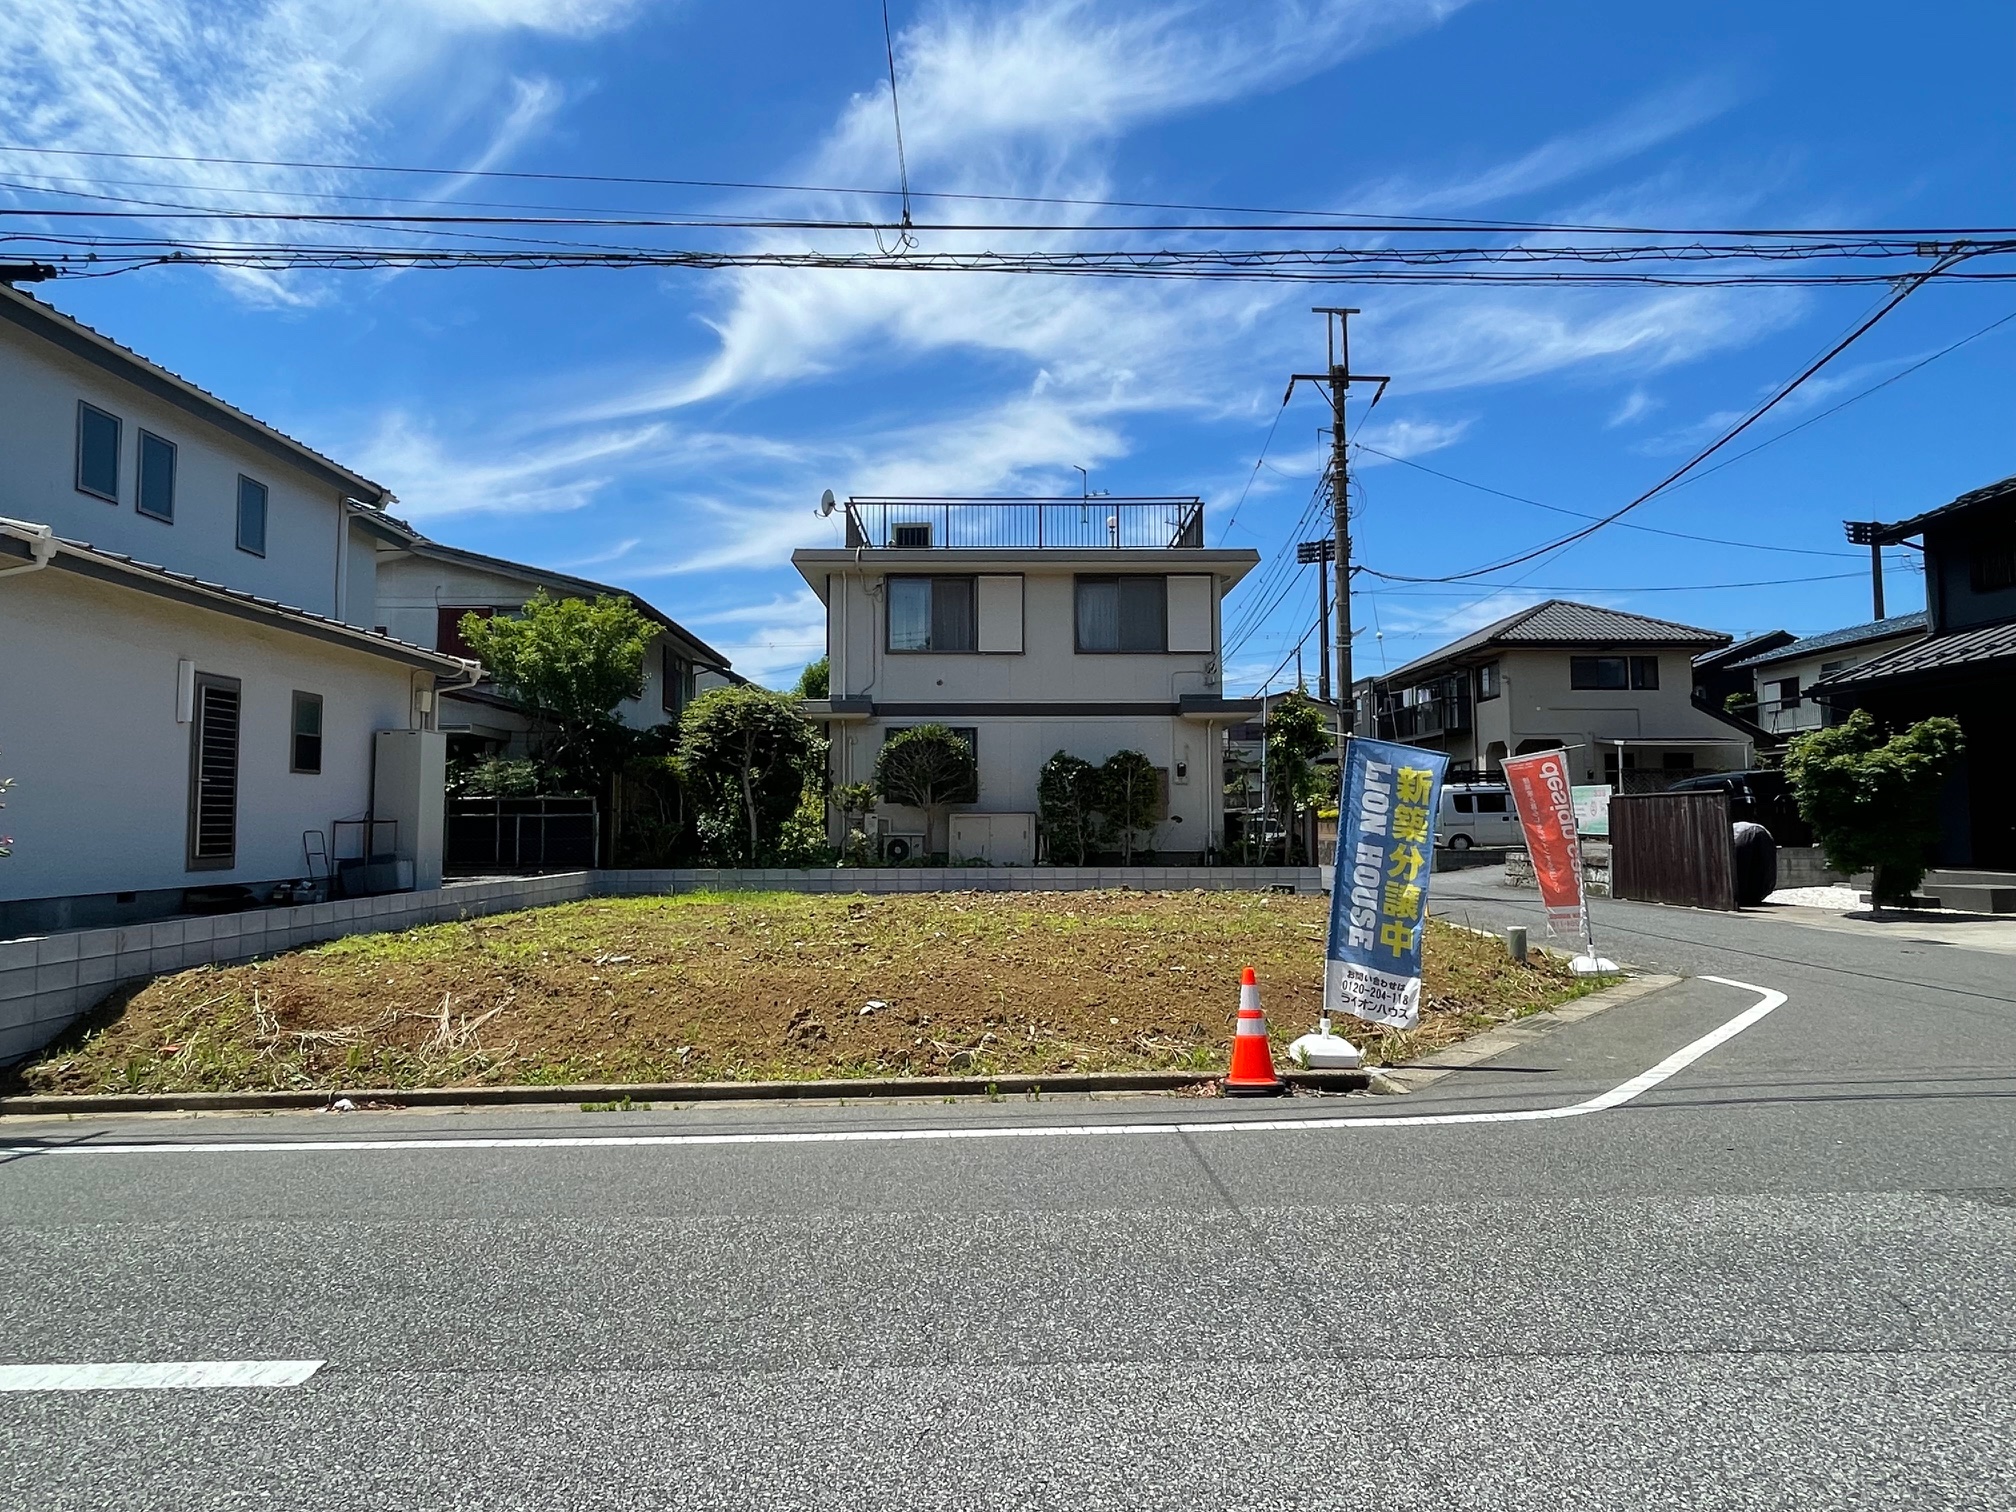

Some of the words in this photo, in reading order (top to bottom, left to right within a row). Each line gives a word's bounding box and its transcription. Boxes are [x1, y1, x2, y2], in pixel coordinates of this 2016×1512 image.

[1359, 759, 1392, 836] LION
[1380, 765, 1434, 958] 新築分譲中
[1348, 842, 1384, 951] HOUSE
[1341, 992, 1409, 1020] ライオンハウス
[1342, 980, 1409, 1006] 0120-204-118
[1347, 970, 1406, 992] お問い合わせは
